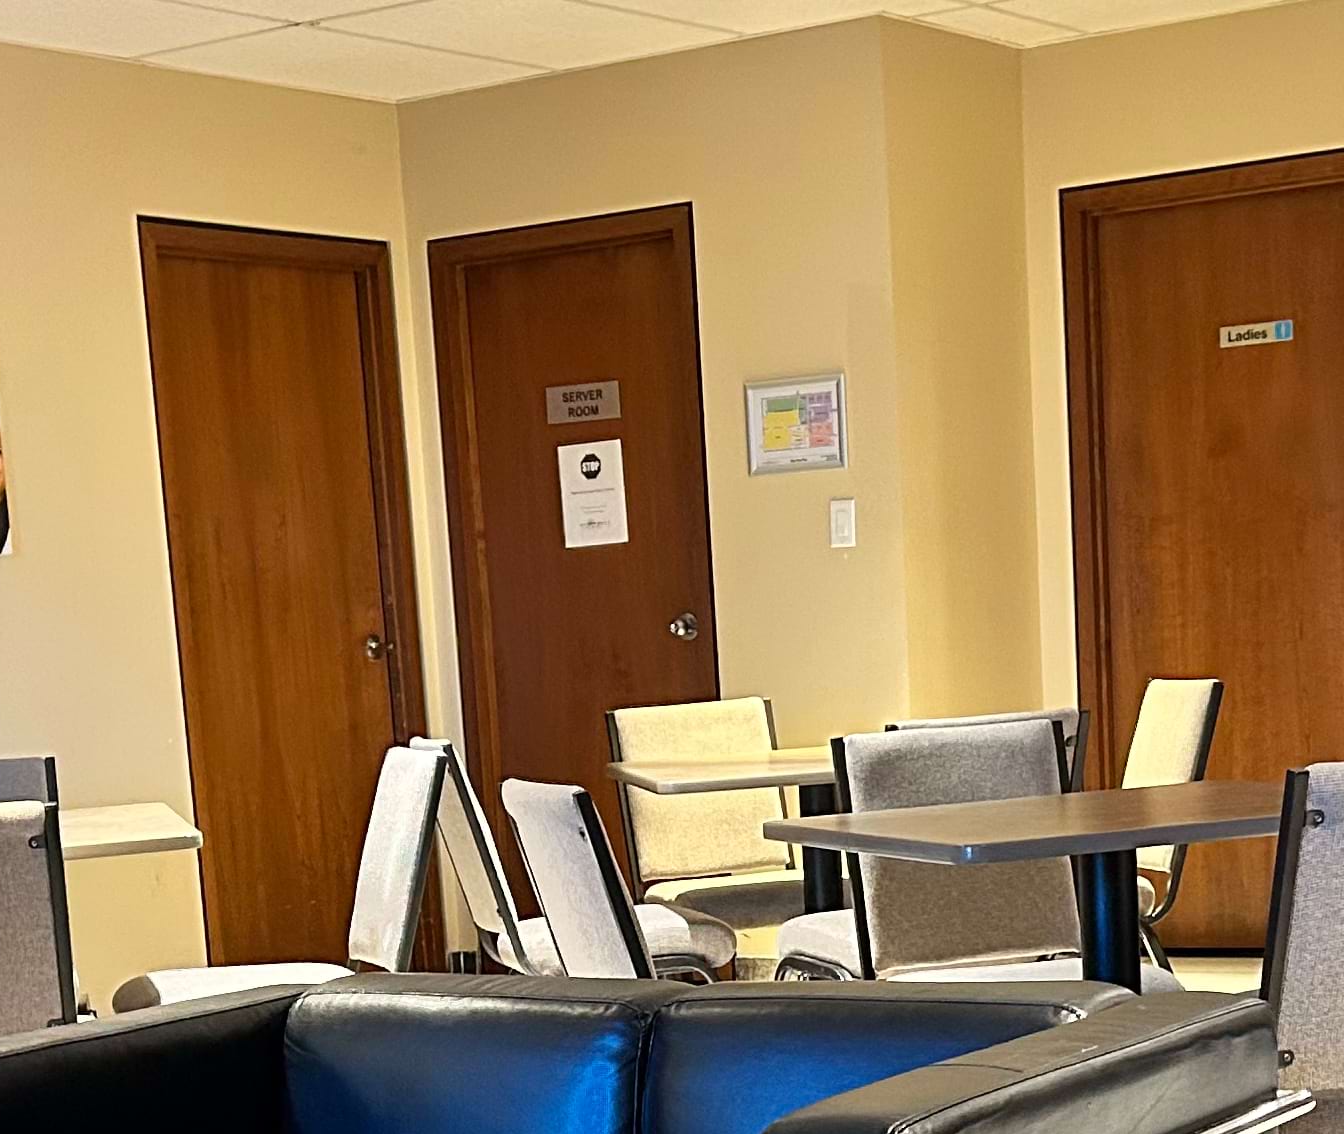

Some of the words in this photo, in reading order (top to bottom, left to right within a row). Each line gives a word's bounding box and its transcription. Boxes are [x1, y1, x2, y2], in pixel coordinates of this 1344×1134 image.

[1227, 328, 1268, 343] Ladies
[561, 388, 604, 403] SERVER
[567, 404, 600, 418] ROOM
